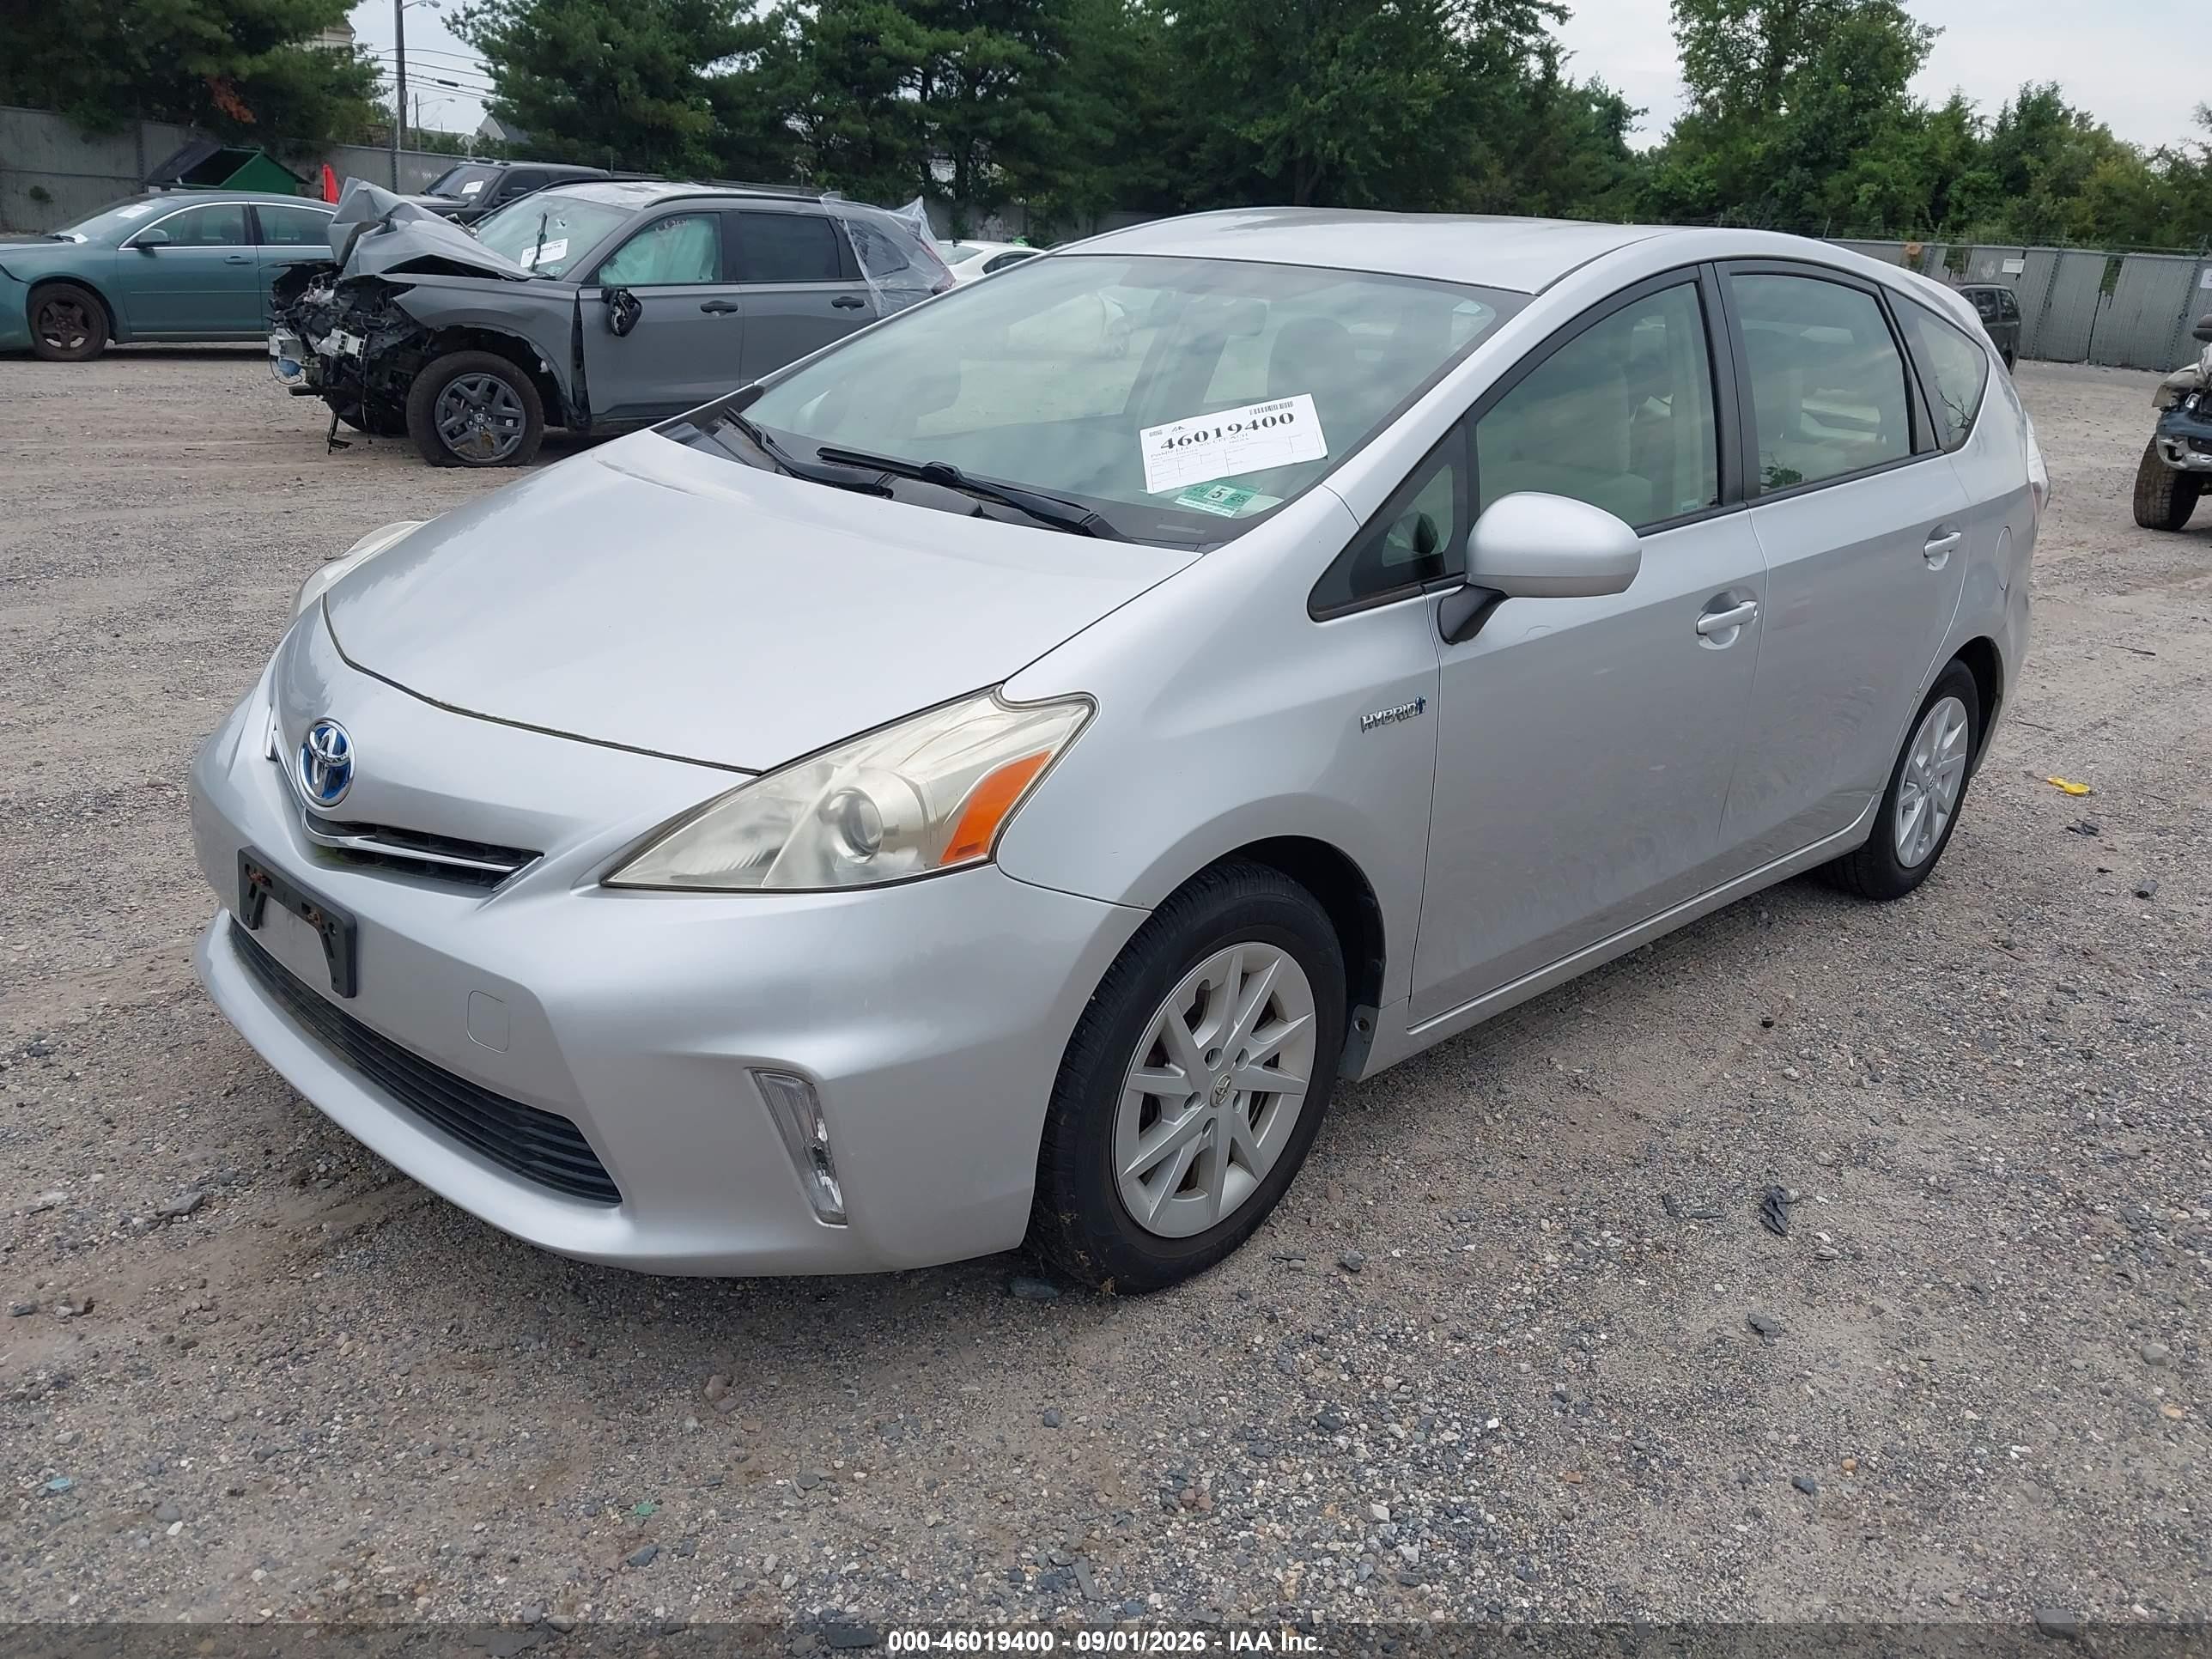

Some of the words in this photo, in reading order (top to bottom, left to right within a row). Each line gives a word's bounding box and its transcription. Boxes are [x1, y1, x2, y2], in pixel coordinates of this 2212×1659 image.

[1160, 412, 1294, 449] 46019400
[1212, 488, 1228, 498] 5
[1230, 494, 1249, 502] 25
[1360, 702, 1419, 733] HYBRID
